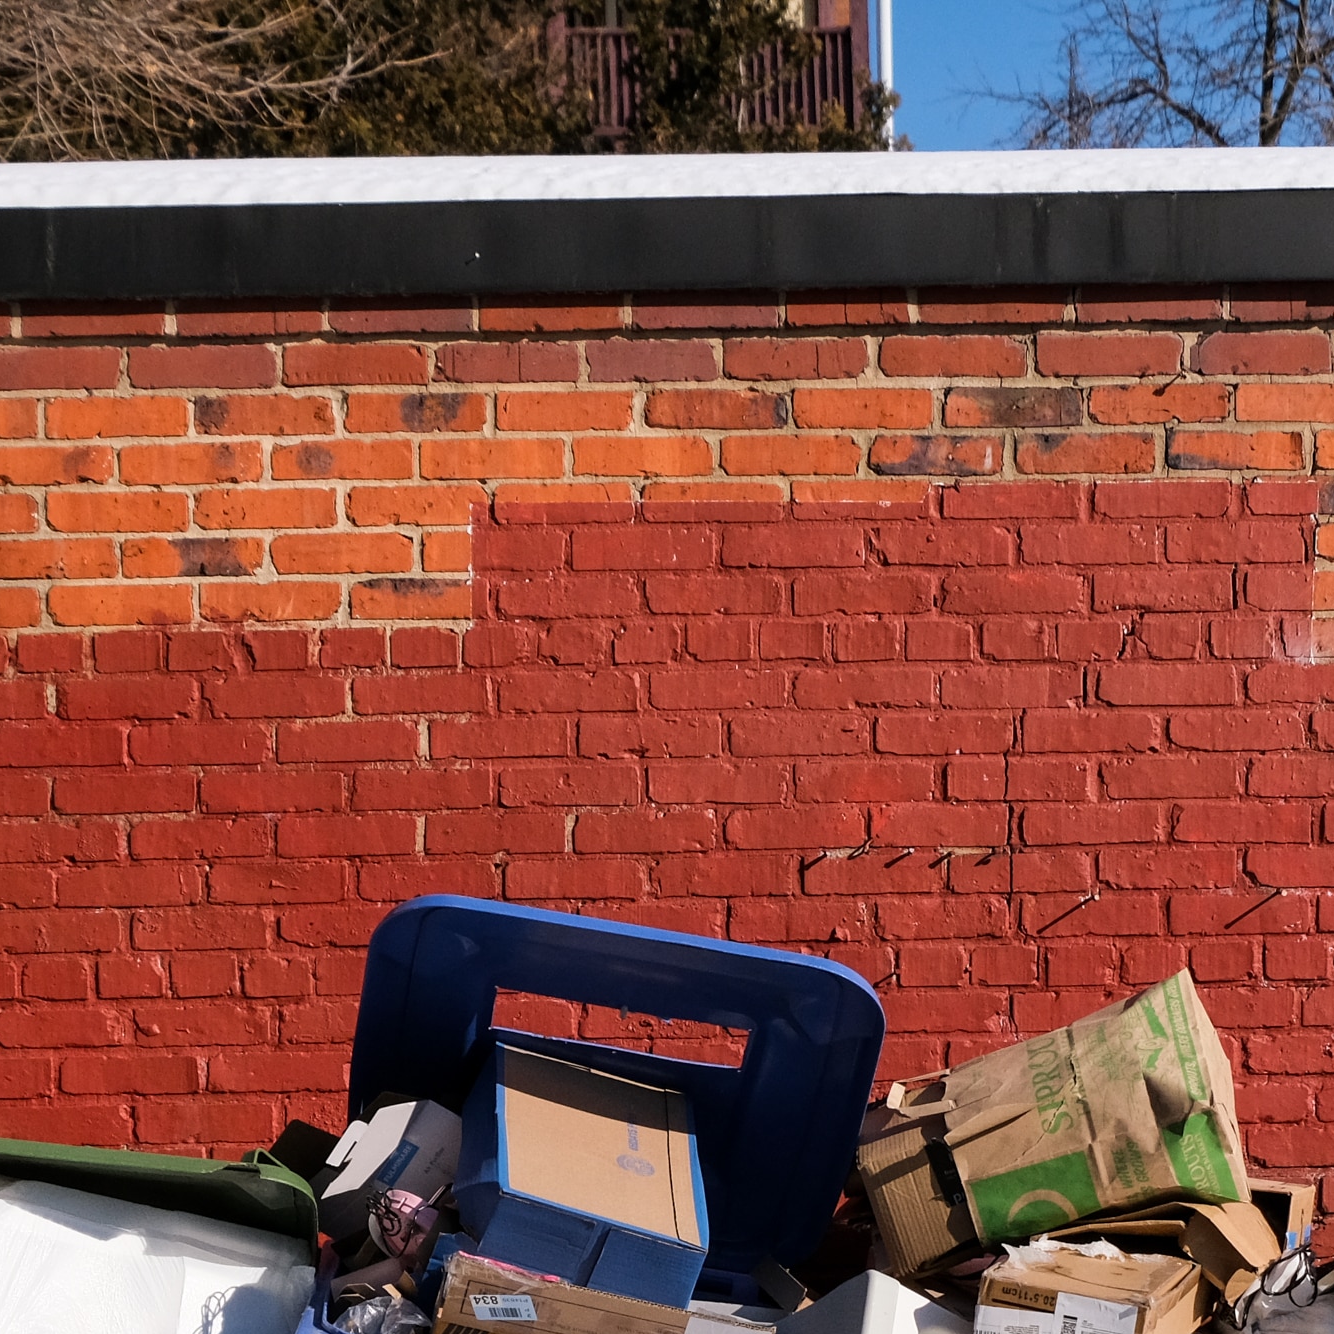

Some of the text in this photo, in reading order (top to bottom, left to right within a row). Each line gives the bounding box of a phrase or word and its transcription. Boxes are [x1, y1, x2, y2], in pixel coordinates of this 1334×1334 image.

[1111, 1148, 1133, 1189] WHERE
[1179, 1134, 1209, 1194] ROUTS
[473, 1295, 499, 1305] 834
